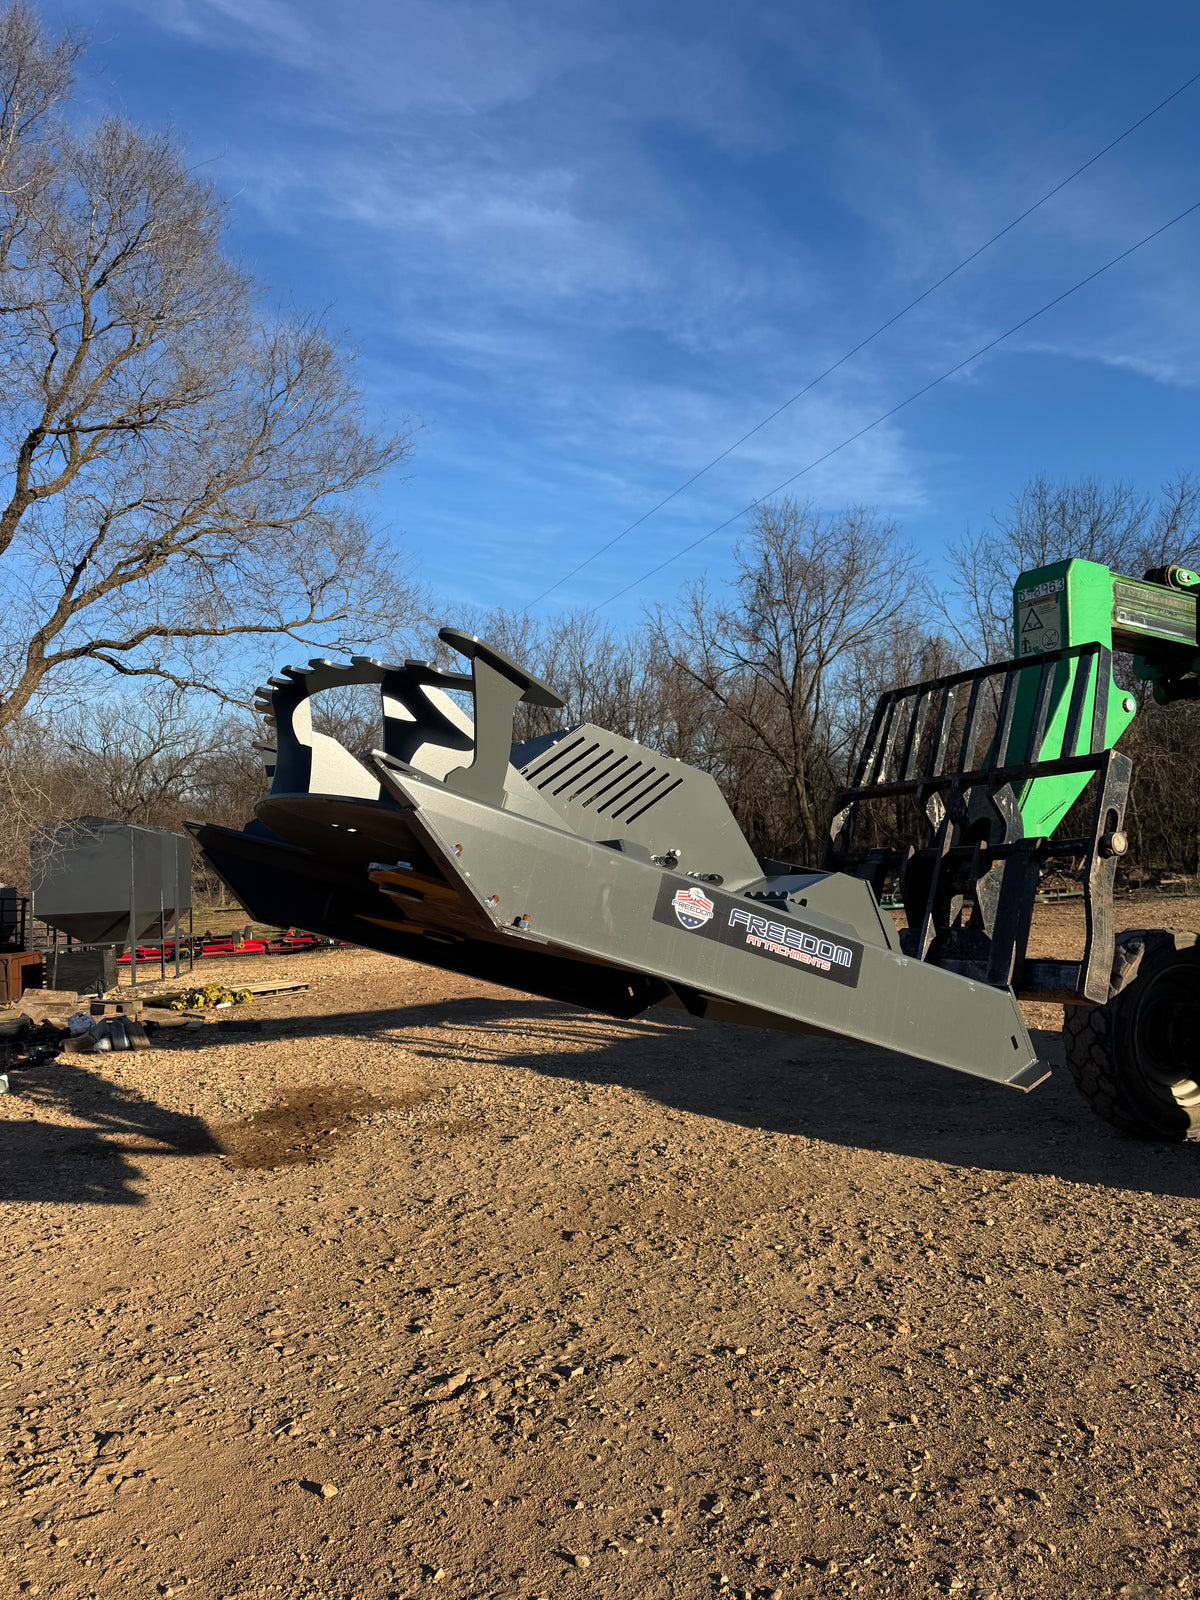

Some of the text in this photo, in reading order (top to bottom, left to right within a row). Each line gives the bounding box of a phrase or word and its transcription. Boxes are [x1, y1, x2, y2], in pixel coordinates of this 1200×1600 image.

[672, 899, 714, 920] FREEDOM
[728, 908, 853, 968] FREEDOM
[746, 934, 831, 972] ATTACHMENTS
